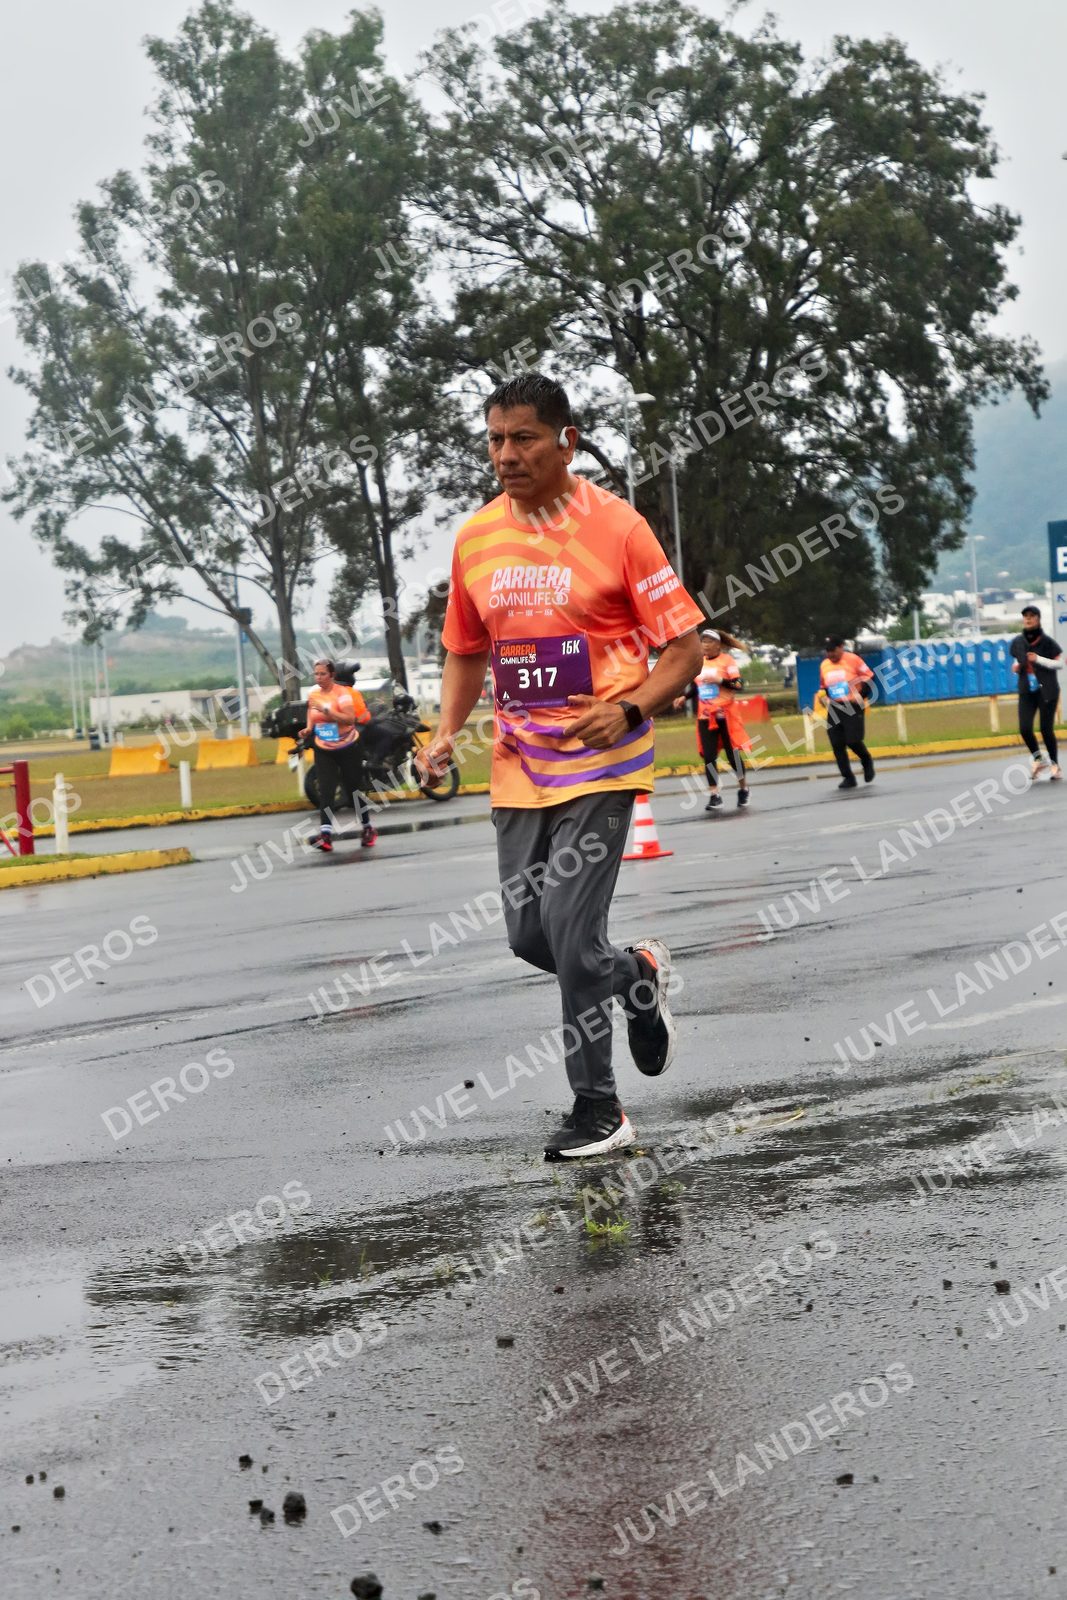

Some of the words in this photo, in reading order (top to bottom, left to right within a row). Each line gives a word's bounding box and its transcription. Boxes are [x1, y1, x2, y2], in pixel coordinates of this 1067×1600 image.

[490, 565, 572, 592] CARRERA
[488, 591, 551, 608] OMNILIFE
[500, 643, 536, 657] CARRERA
[561, 639, 581, 656] 15K
[500, 657, 528, 665] OMNILIFE
[517, 666, 558, 689] 317
